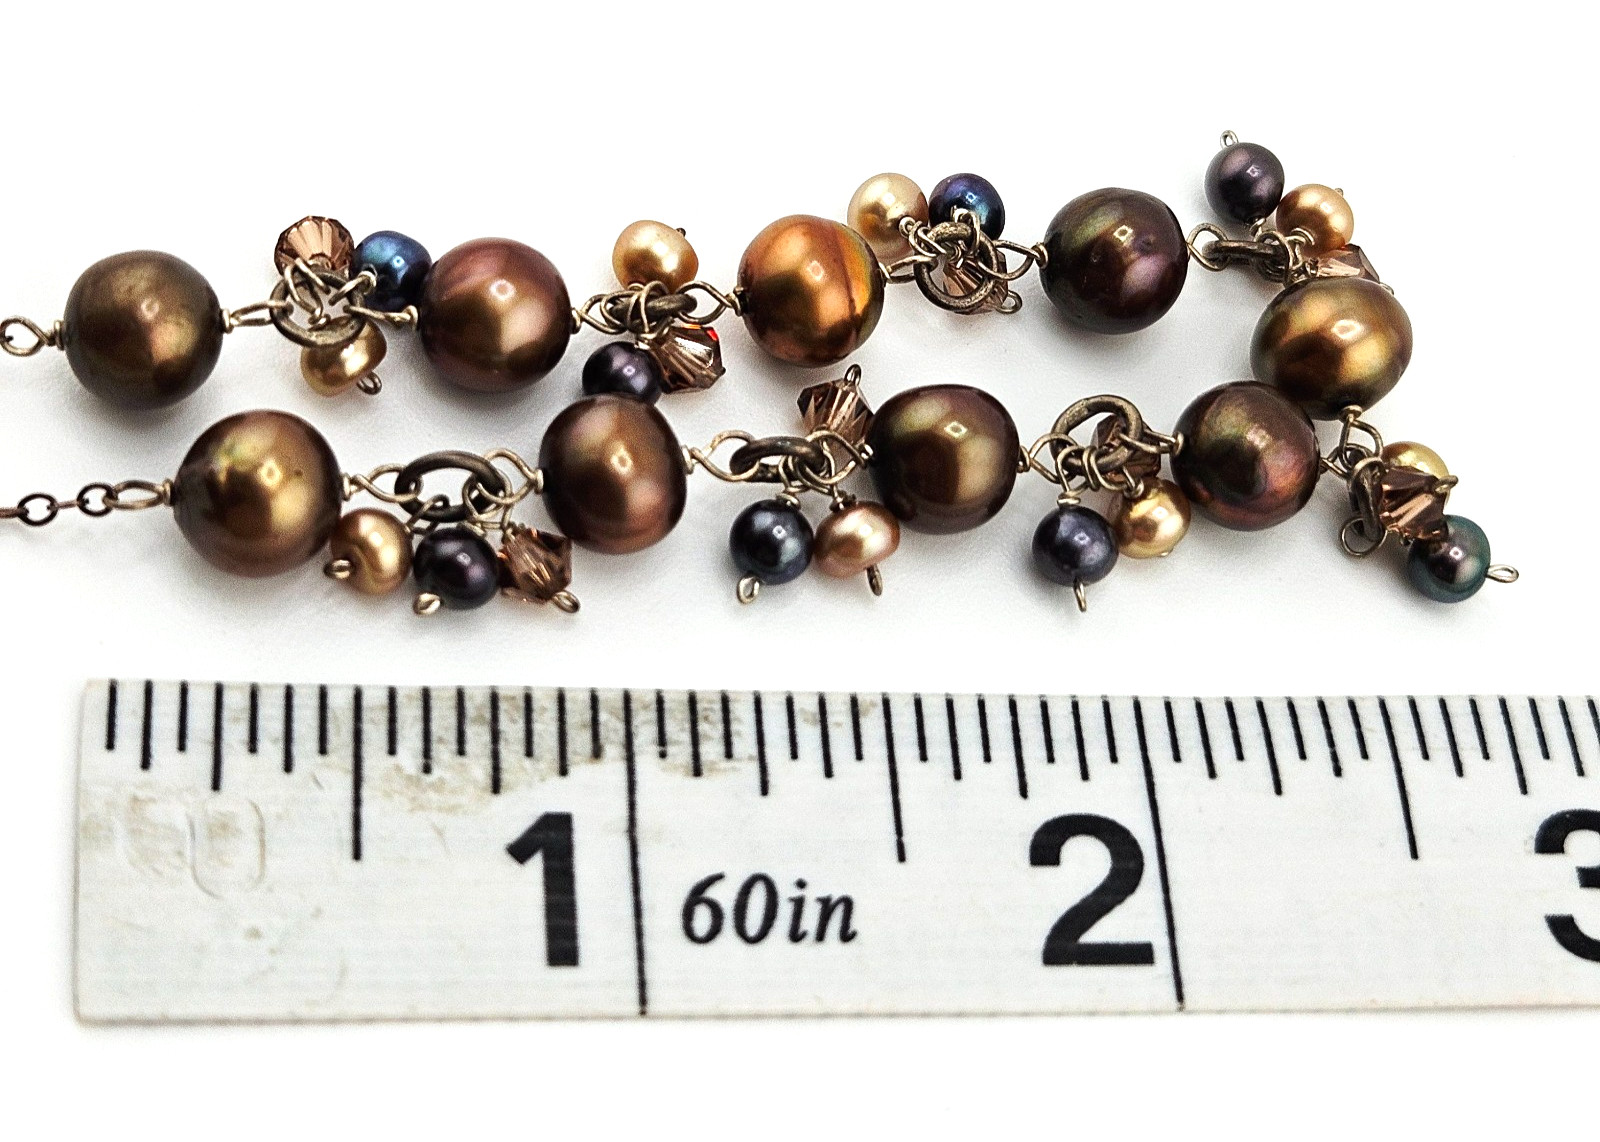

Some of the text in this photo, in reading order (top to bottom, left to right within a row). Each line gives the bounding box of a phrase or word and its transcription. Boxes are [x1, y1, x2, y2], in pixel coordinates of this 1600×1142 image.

[505, 812, 580, 968] 1
[681, 873, 858, 945] 60in
[1028, 813, 1155, 967] 2
